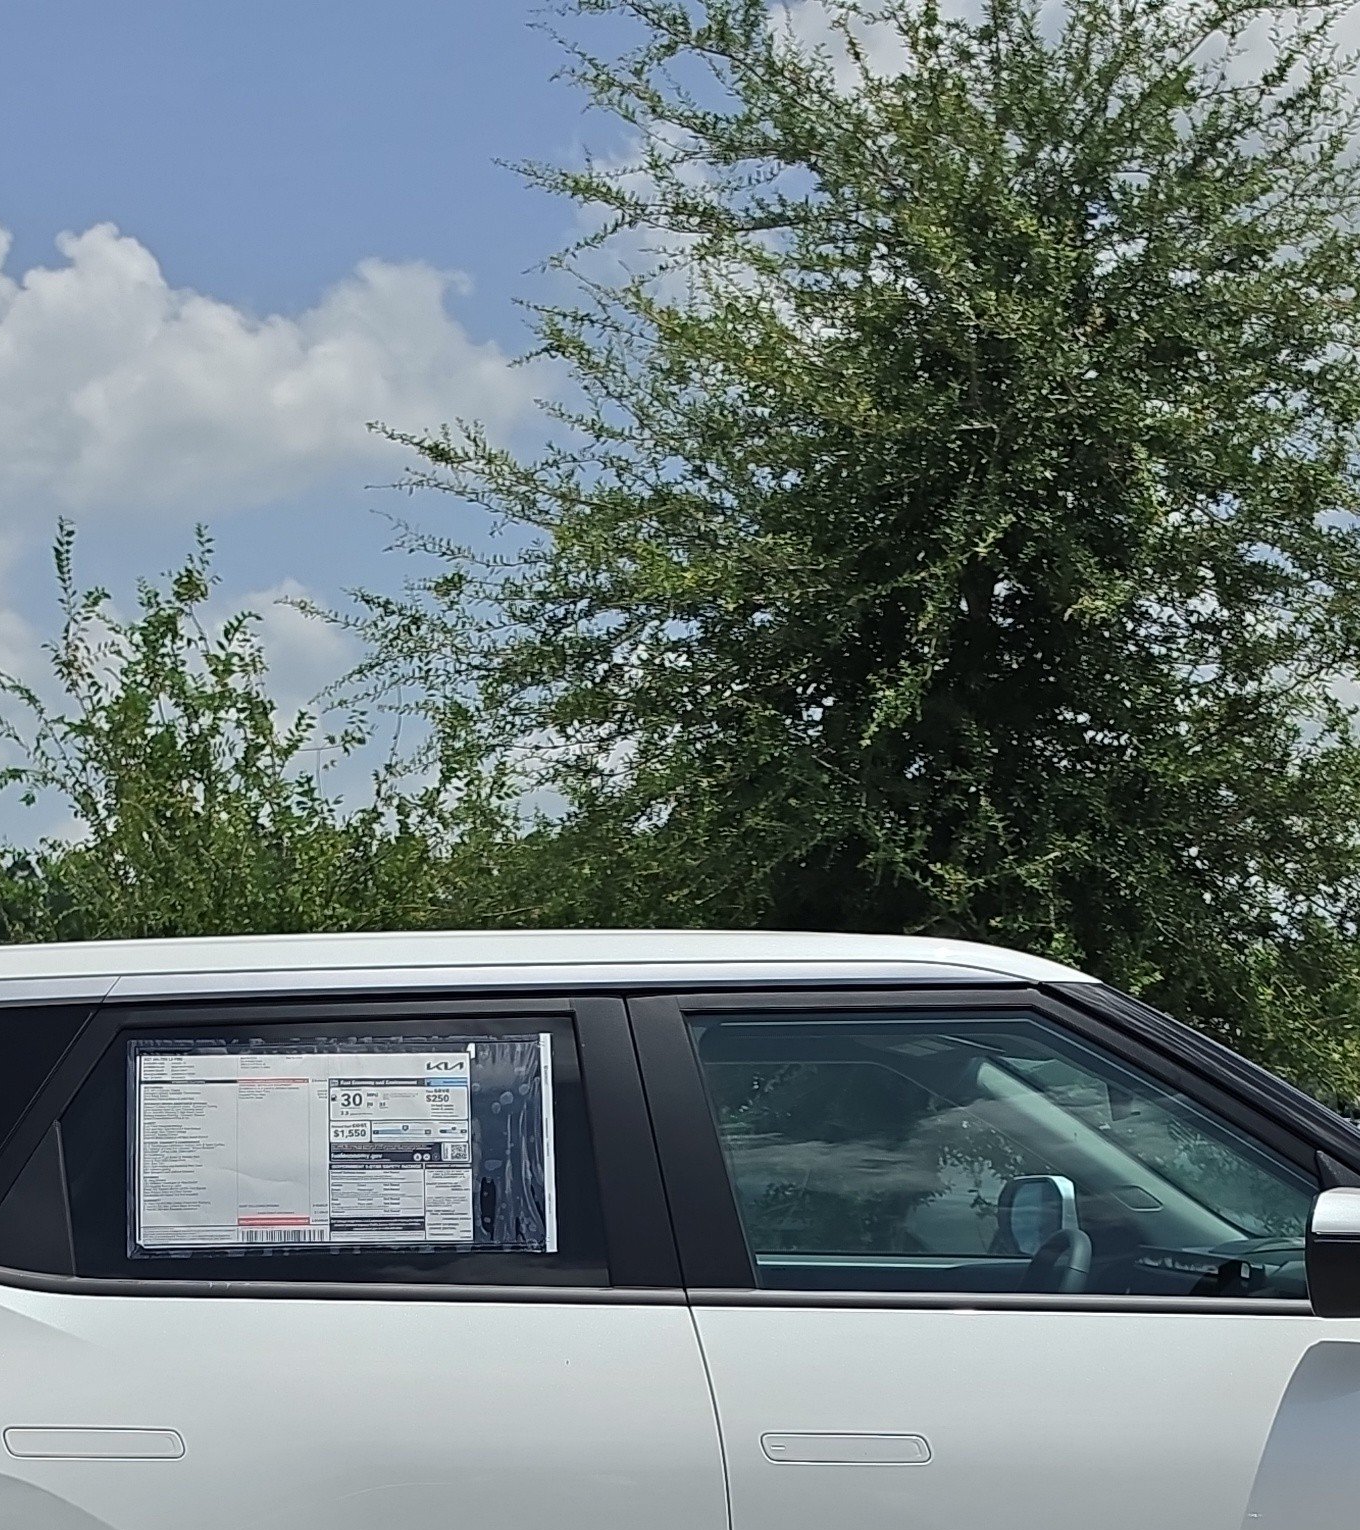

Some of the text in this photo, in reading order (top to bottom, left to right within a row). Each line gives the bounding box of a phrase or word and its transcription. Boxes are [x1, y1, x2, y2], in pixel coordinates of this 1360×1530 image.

[426, 1061, 465, 1071] KIA
[340, 1092, 363, 1107] 30
[425, 1094, 450, 1103] $250
[333, 1129, 367, 1139] $1,550
